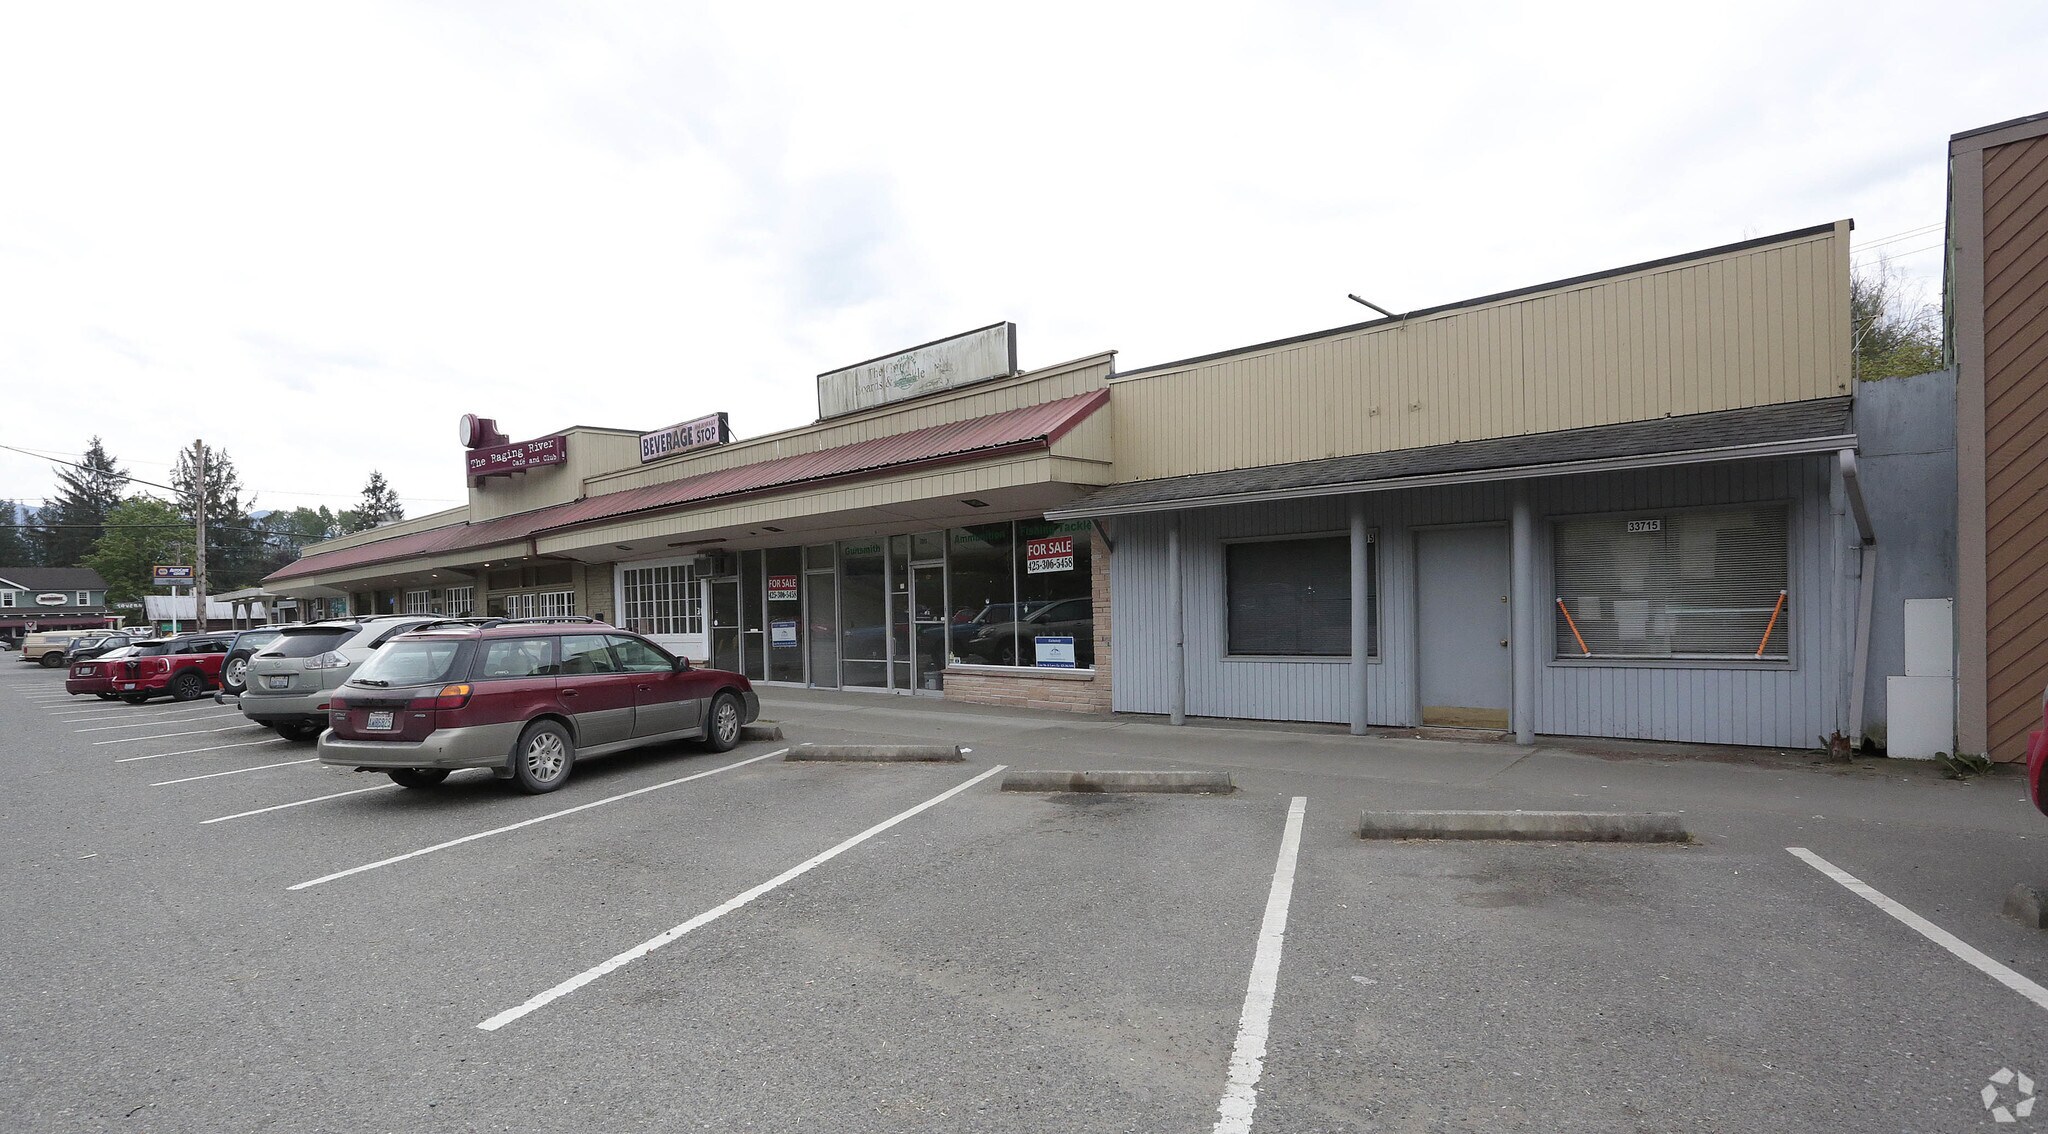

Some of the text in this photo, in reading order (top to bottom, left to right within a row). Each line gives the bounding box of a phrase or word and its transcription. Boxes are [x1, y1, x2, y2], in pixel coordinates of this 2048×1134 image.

[642, 426, 716, 457] BEVERAGE STOP
[470, 439, 554, 468] The Raging River
[543, 454, 557, 462] Club
[1059, 519, 1092, 532] Tackle
[1629, 521, 1658, 531] 33715
[845, 544, 880, 555] Gunsmith
[1028, 540, 1072, 556] FOR SALE
[1028, 557, 1073, 571] 425-306-5458
[768, 578, 797, 588] FOR SALE
